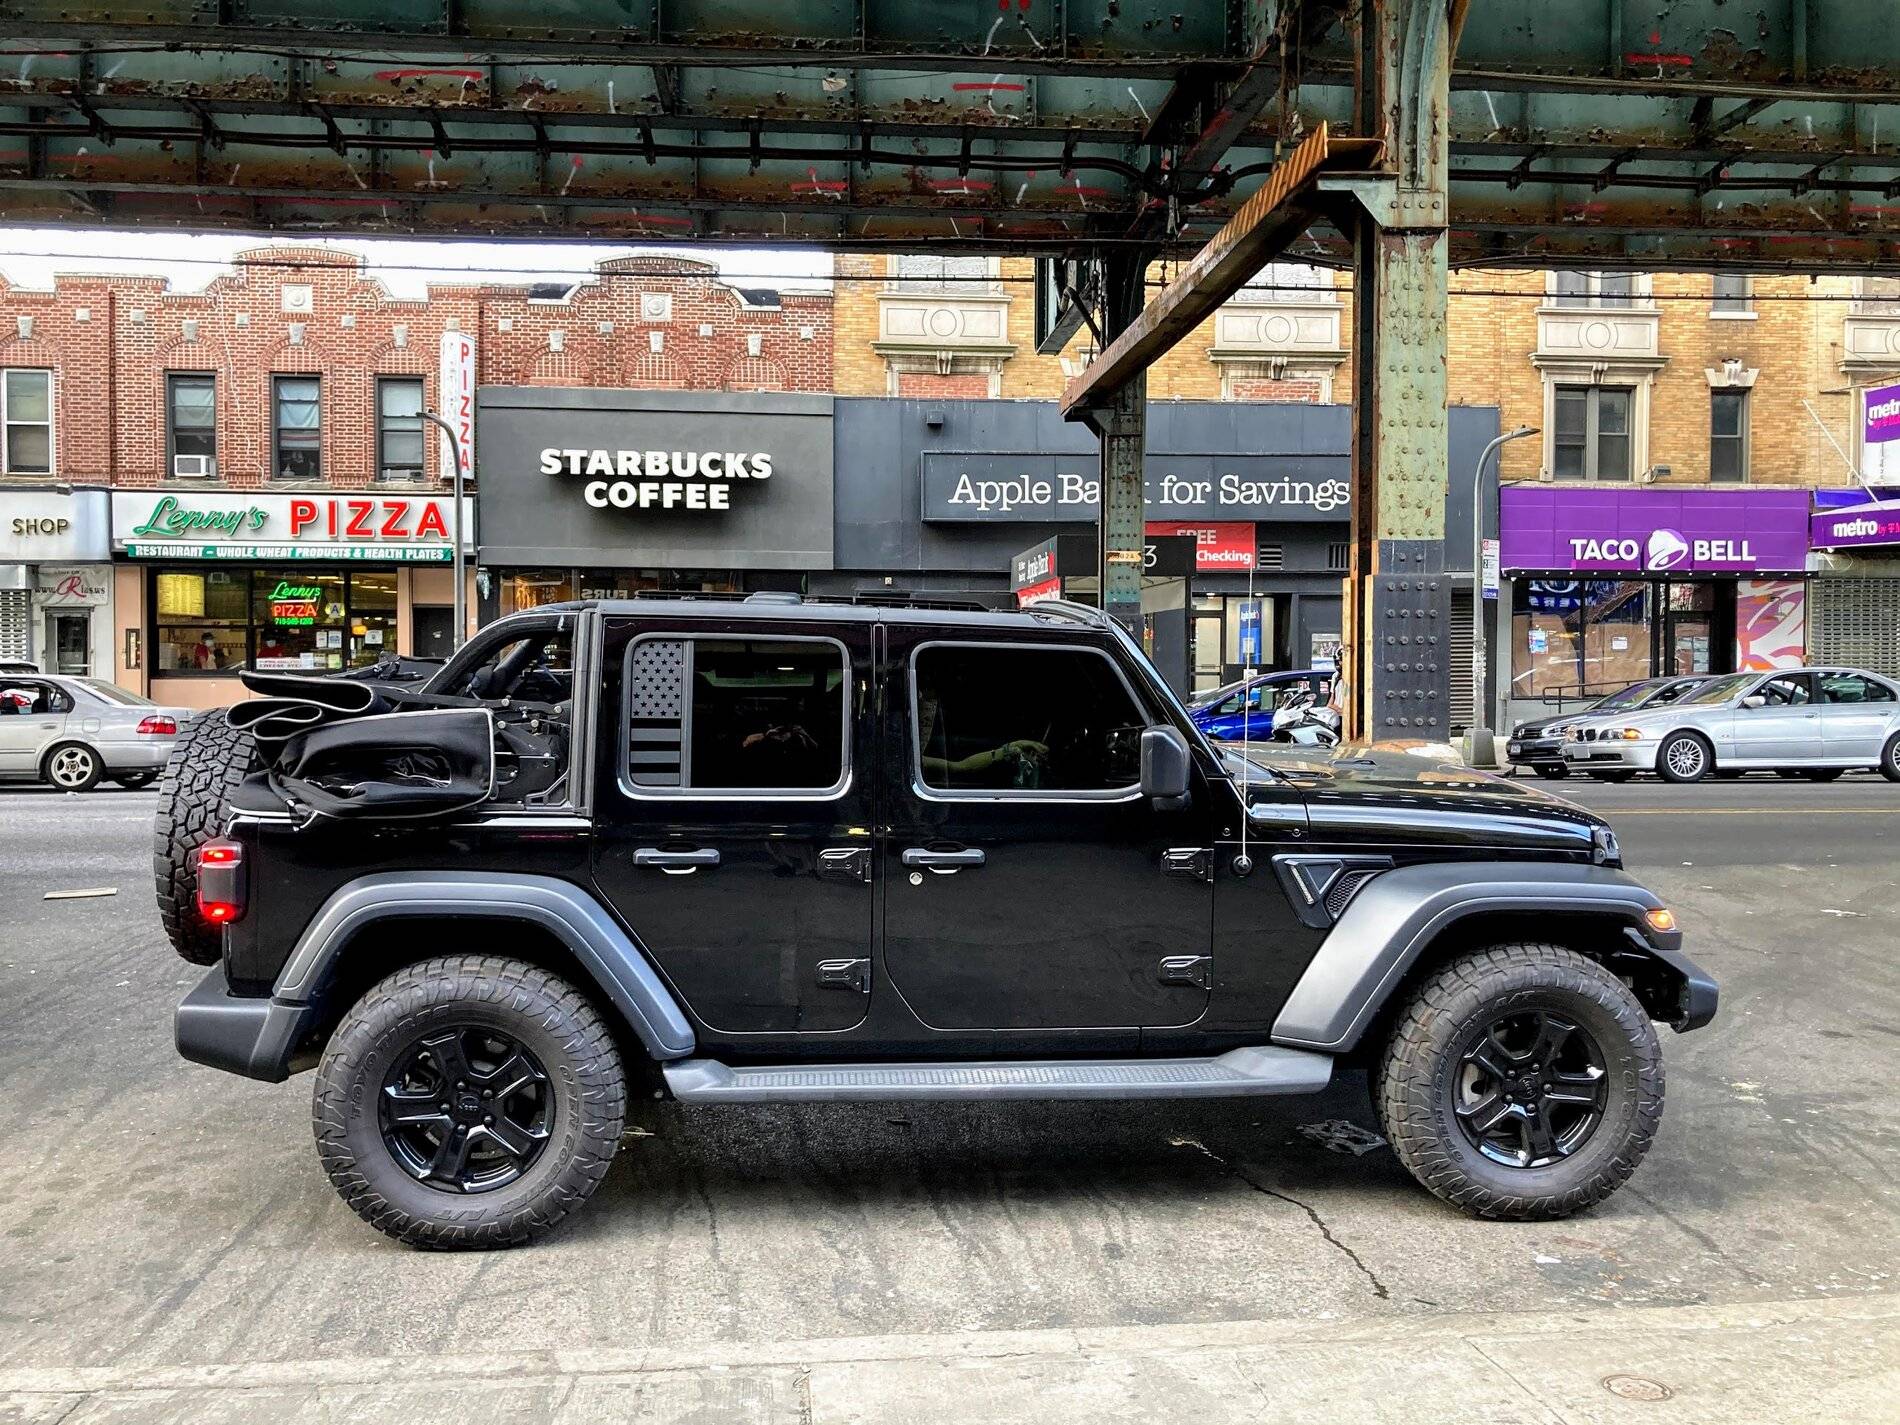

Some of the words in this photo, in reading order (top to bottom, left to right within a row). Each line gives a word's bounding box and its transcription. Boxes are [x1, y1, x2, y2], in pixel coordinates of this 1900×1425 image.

[460, 342, 470, 471] PIZZA
[540, 448, 773, 479] STARBUCKS
[584, 481, 730, 510] COFFEE
[948, 473, 1052, 511] Apple
[1058, 474, 1152, 504] Ba
[1159, 475, 1212, 504] for
[1219, 475, 1350, 511] Savings
[12, 518, 70, 536] SHOP
[133, 496, 268, 538] Lenny's
[290, 500, 450, 539] PIZZA
[1833, 517, 1878, 537] metro
[135, 545, 203, 557] RESTAURANT
[217, 546, 253, 558] WHOLE
[256, 546, 292, 558] WHEAT
[296, 547, 350, 559] PRODUCTS
[354, 547, 361, 558] &
[365, 547, 402, 559] HEALTH
[406, 548, 444, 559] PLATES
[1196, 549, 1252, 565] Checking
[1570, 539, 1639, 561] TACO
[1694, 540, 1757, 561] BELL
[274, 604, 317, 617] PIZZA
